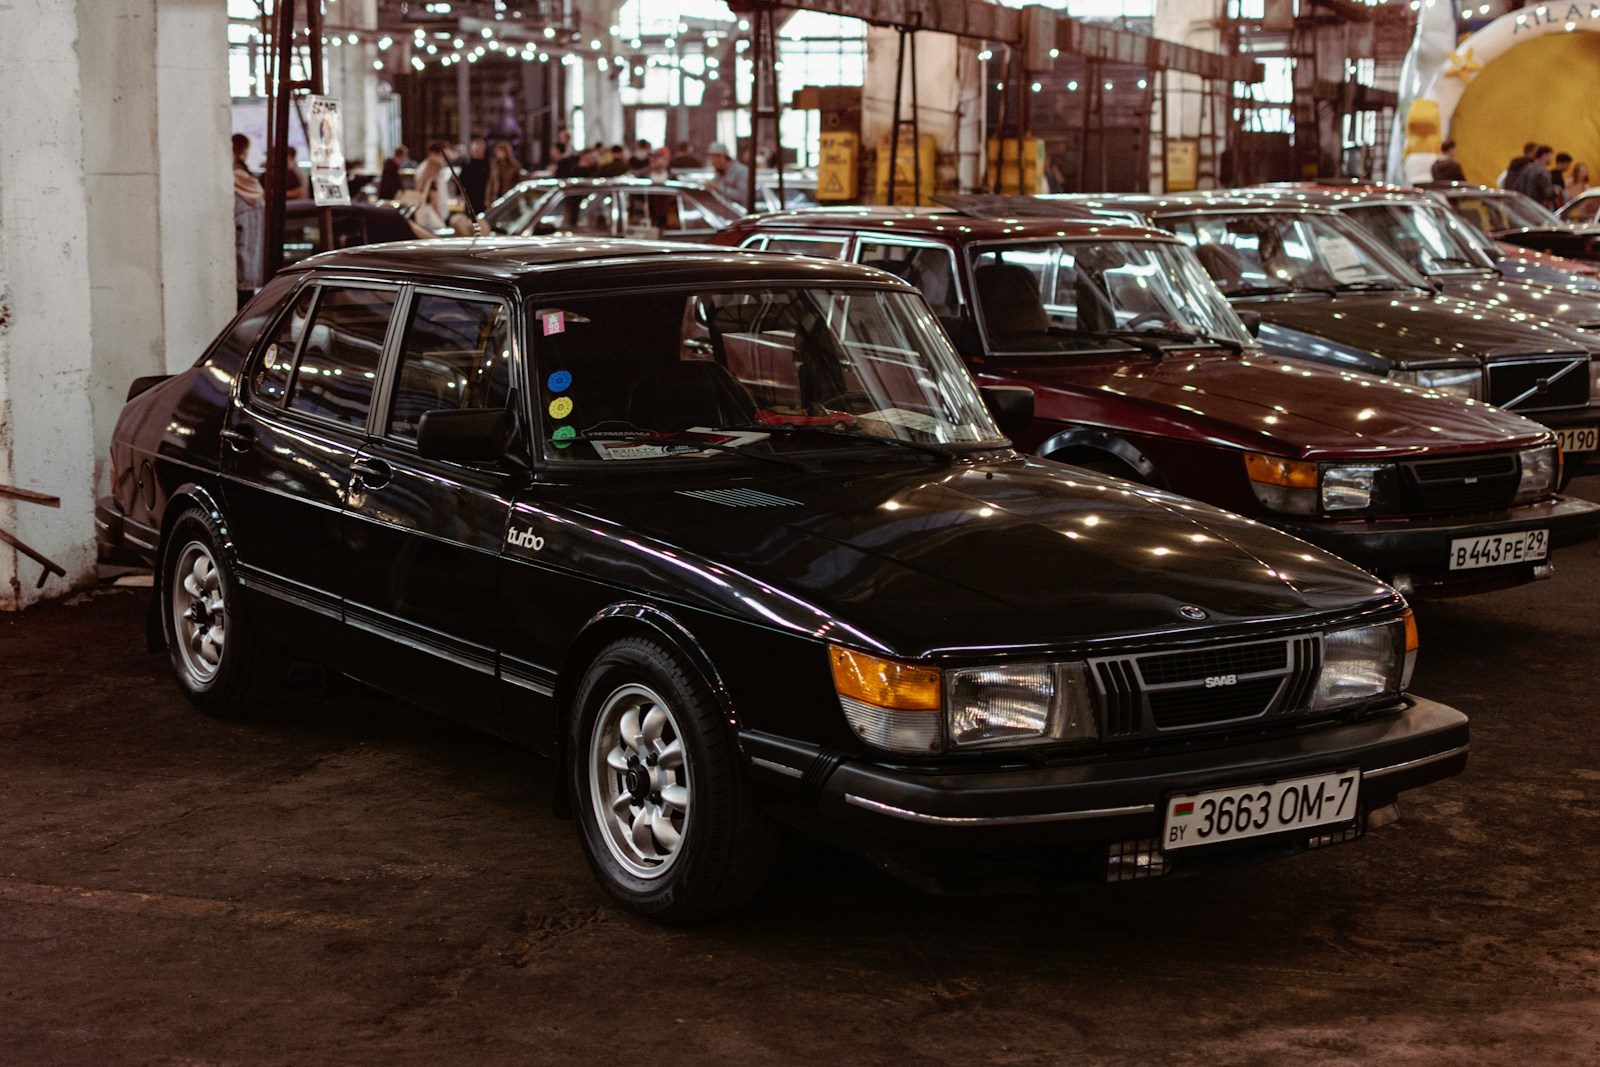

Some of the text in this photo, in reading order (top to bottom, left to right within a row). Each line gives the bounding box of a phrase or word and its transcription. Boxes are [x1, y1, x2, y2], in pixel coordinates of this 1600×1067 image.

[507, 526, 545, 551] turbo
[1527, 532, 1544, 550] 29
[1204, 674, 1237, 689] SAAB
[1197, 776, 1355, 838] 3663 OM-7
[1169, 825, 1188, 842] BY
